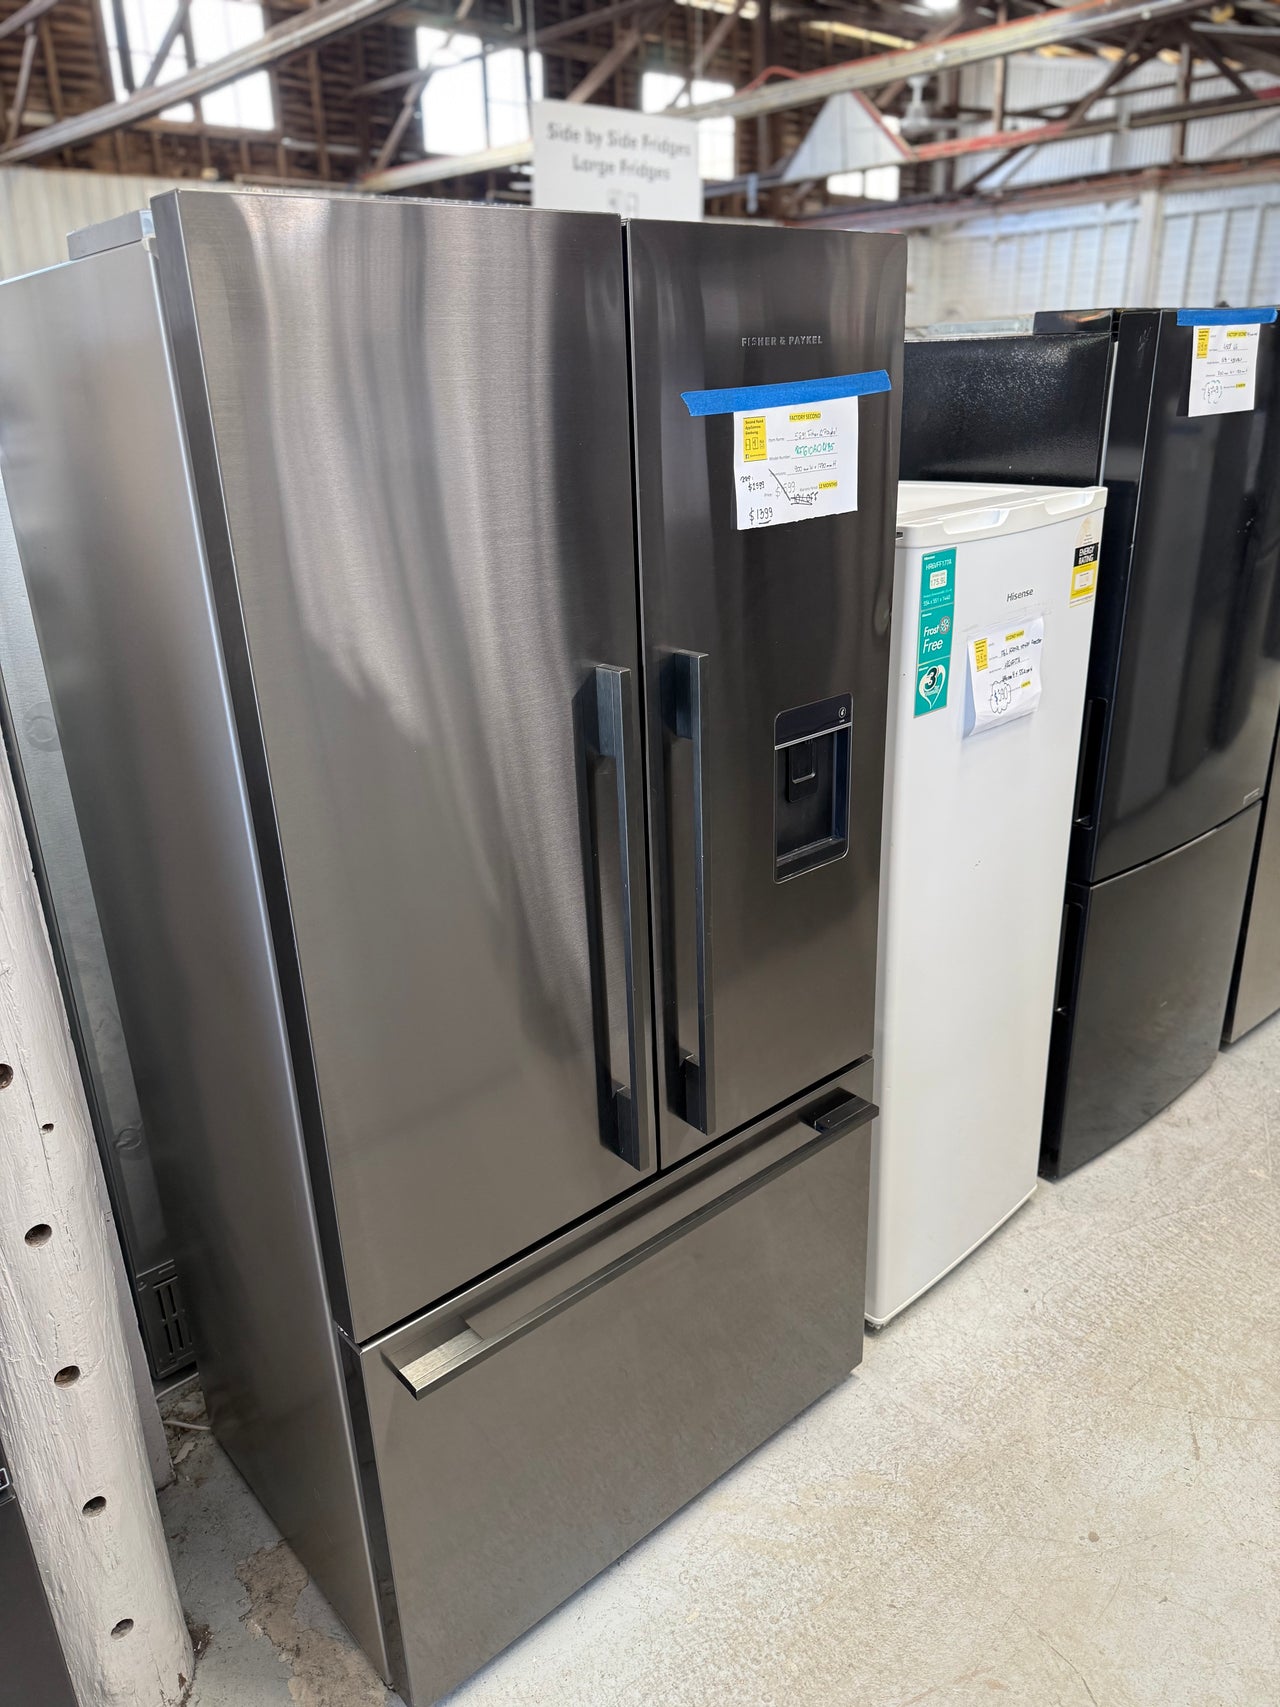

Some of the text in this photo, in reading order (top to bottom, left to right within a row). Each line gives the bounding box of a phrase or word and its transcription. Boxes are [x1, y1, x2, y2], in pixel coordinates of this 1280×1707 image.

[547, 120, 691, 158] Side by Side Fridges
[572, 153, 671, 182] Large Fridges
[741, 335, 823, 347] FISHER & PAYKEL
[789, 412, 821, 421] FACTORY SECOND
[748, 507, 774, 526] $1399
[1078, 554, 1095, 565] RATING
[1079, 546, 1095, 557] ENERGY
[1006, 587, 1034, 603] Hisense
[923, 625, 940, 637] Frost
[923, 638, 944, 654] Free
[926, 666, 938, 690] 3
